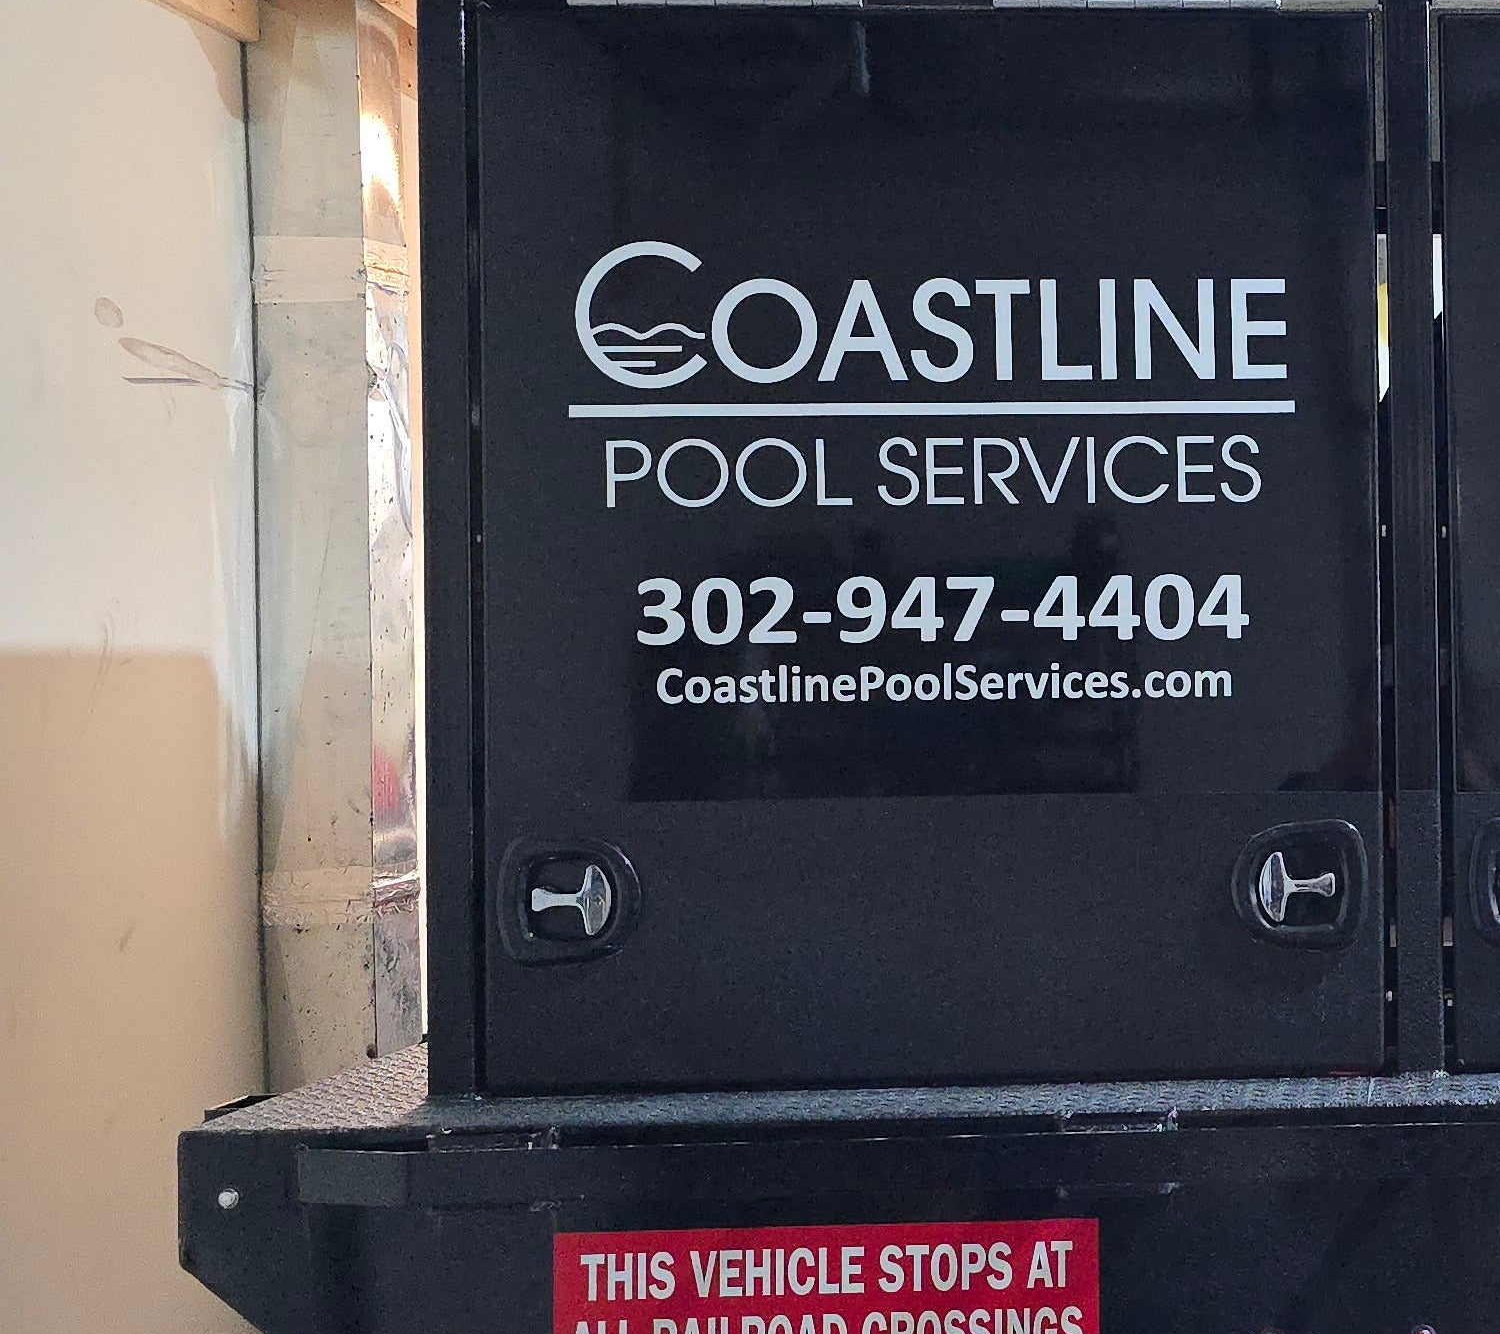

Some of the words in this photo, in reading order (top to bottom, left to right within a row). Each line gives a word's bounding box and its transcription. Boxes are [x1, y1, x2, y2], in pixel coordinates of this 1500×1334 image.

[574, 240, 1288, 389] COASTLINE
[605, 437, 853, 508] POOL
[877, 434, 1262, 506] SERVICES
[636, 573, 1250, 646] 302-947-4404
[656, 662, 1232, 705] CoastlinePoolServices.com
[580, 1251, 676, 1302] THIS
[689, 1246, 866, 1299] VEHICLE
[877, 1241, 1014, 1293] STOPS
[1026, 1240, 1074, 1289] AT
